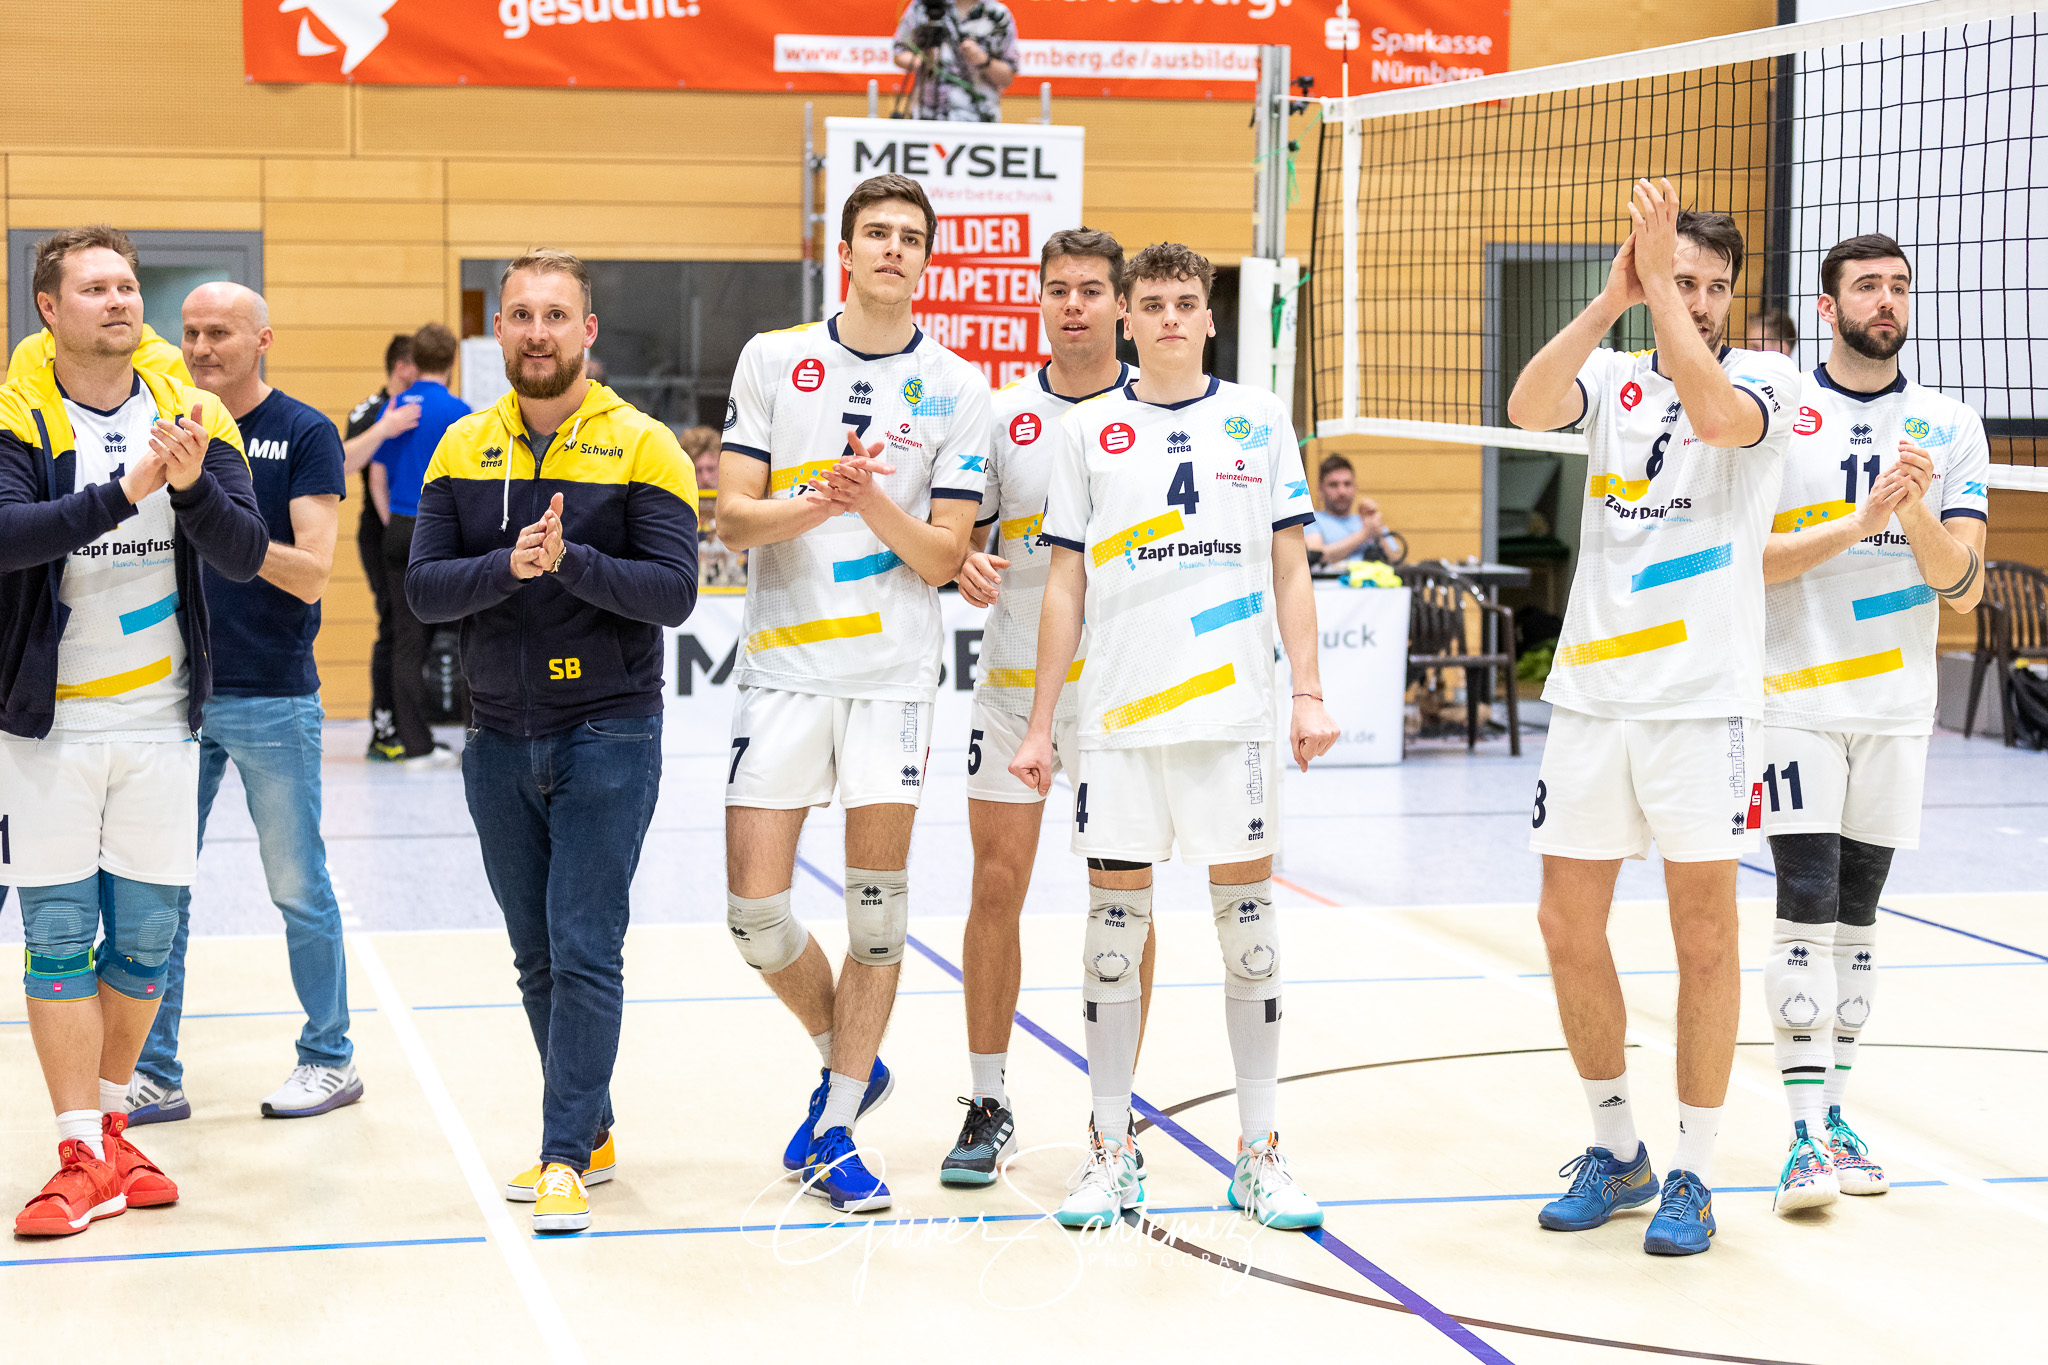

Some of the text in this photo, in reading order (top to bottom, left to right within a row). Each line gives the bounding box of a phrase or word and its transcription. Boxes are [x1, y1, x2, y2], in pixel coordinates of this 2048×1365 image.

[1371, 26, 1493, 57] Sparkasse
[854, 140, 1058, 180] MEYSEL
[930, 184, 1055, 203] Werbetechnik
[248, 437, 288, 460] MM
[580, 443, 624, 459] Schwaig
[842, 412, 873, 457] 7
[1646, 432, 1671, 482] 8
[1166, 461, 1200, 515] 4
[1216, 472, 1263, 484] Heinzelmann
[1840, 453, 1880, 504] 11
[1604, 494, 1638, 520] Zapf
[112, 538, 175, 557] Daigfuss
[1137, 538, 1242, 562] Zapf Daigfuss
[548, 657, 582, 680] SB
[728, 736, 751, 785] 7
[967, 729, 984, 776] 5
[1762, 760, 1804, 812] 11
[1076, 782, 1089, 833] 4
